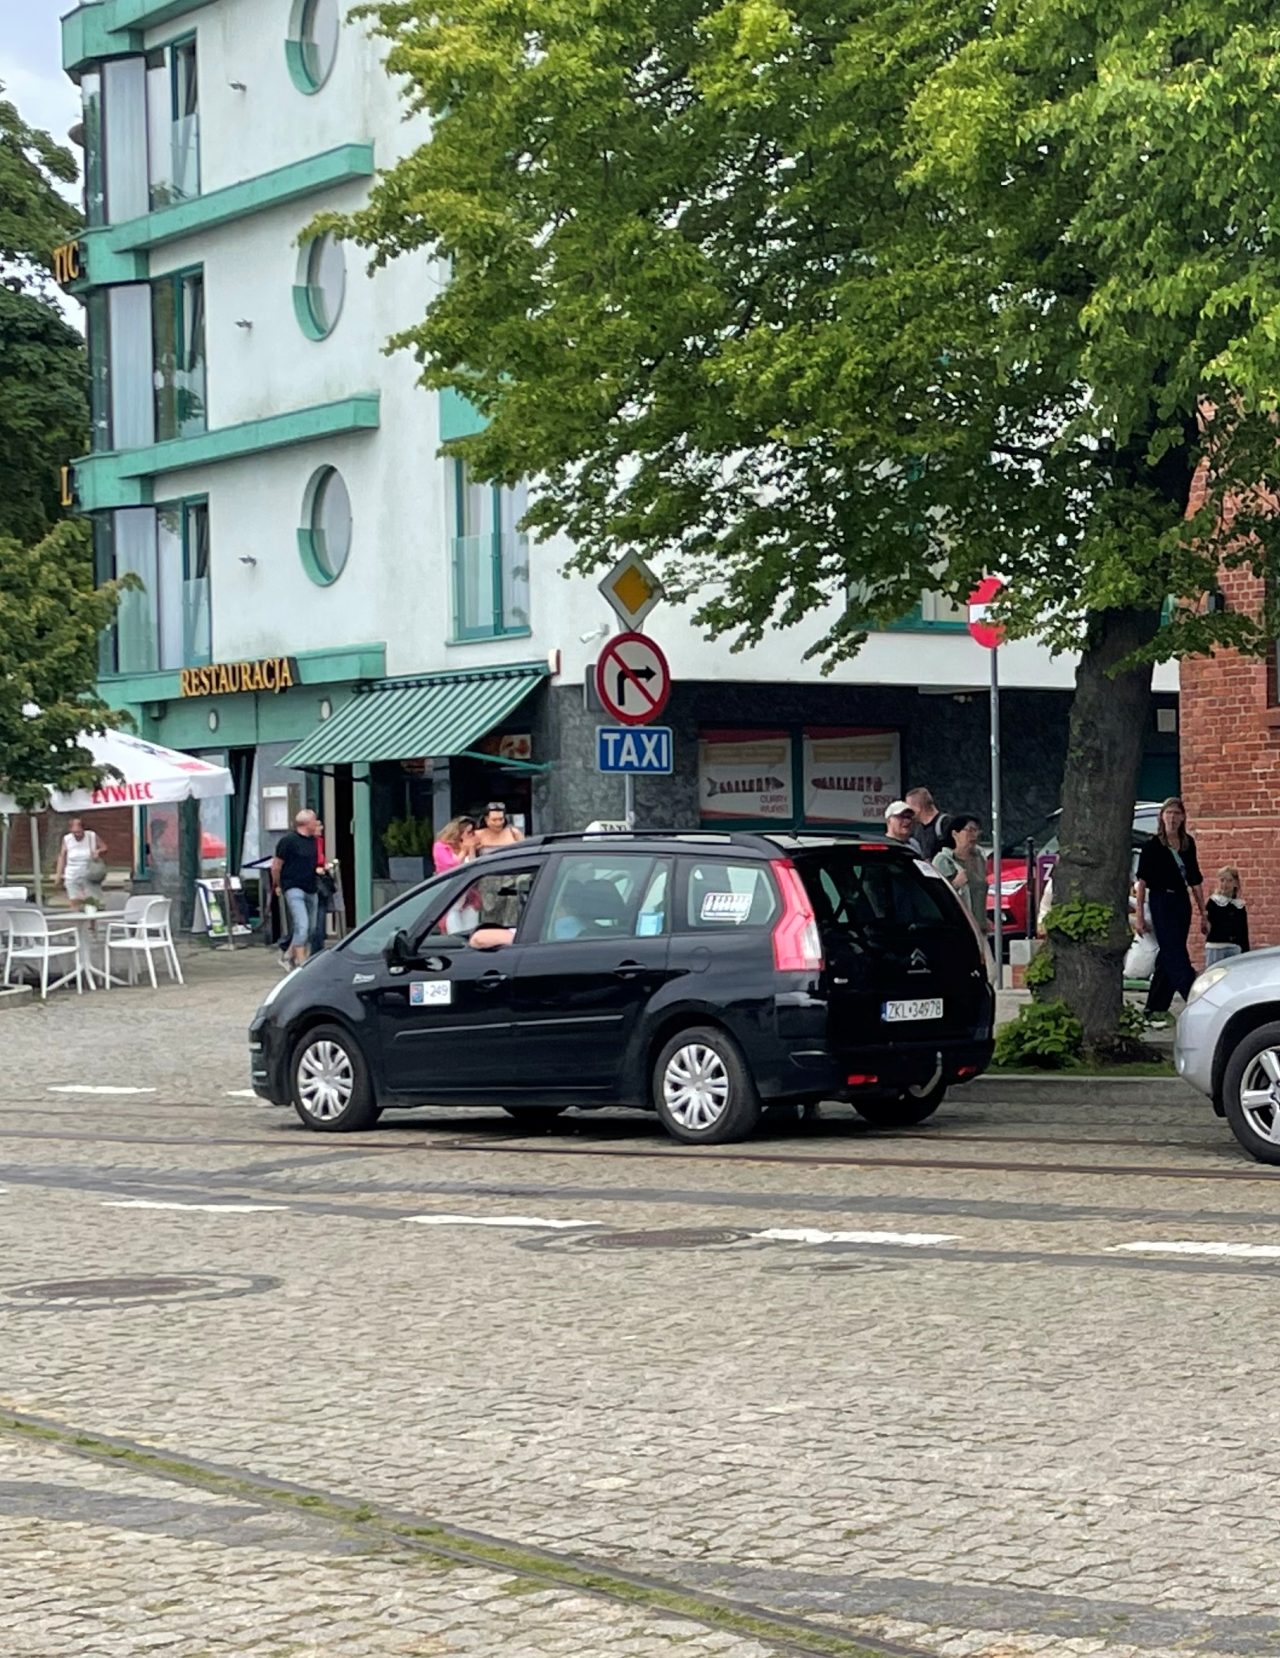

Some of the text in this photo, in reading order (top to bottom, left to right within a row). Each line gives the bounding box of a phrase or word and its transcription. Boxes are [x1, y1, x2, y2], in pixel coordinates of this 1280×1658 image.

[181, 657, 293, 697] RESTAURACJA
[602, 733, 668, 768] TAXI
[430, 984, 449, 998] 249
